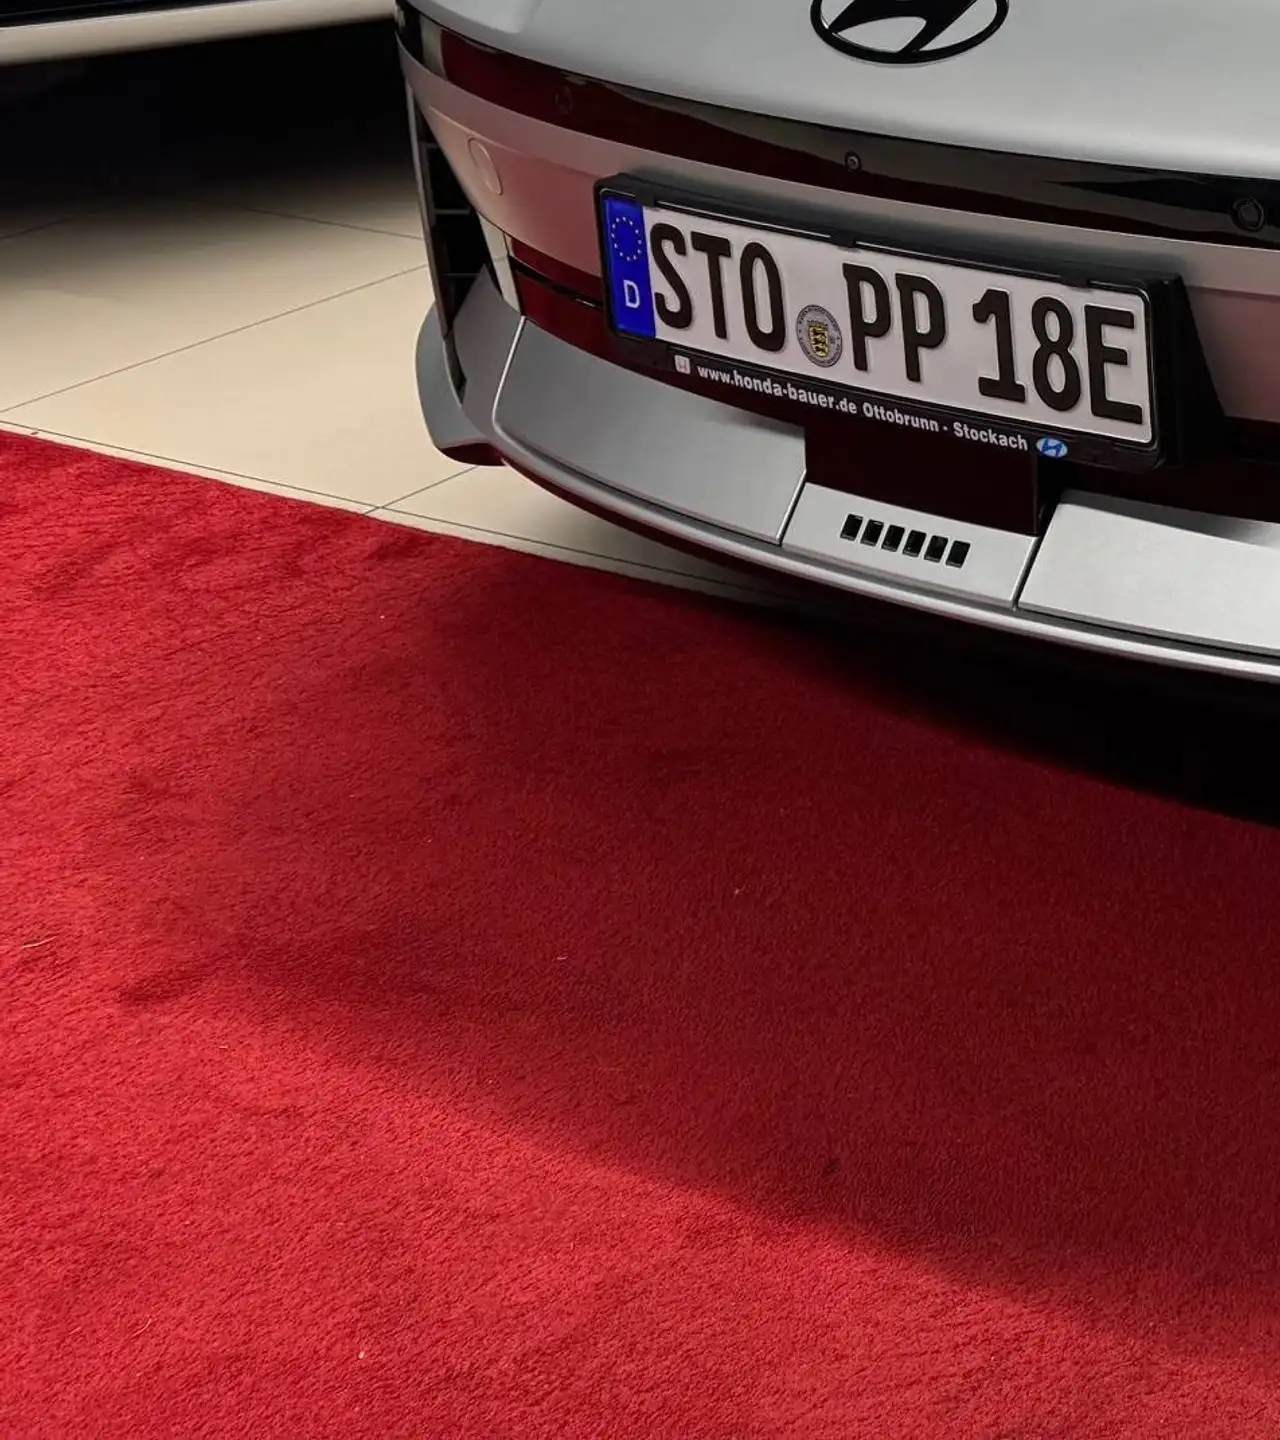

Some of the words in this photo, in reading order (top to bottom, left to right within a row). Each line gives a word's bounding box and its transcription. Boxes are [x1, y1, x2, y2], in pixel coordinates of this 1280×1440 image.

[623, 279, 641, 309] D
[649, 222, 786, 353] STO
[842, 262, 947, 383] PP
[972, 288, 1143, 425] 18E
[697, 364, 858, 415] www.honda-bauer.de
[862, 401, 940, 433] Ottobrunn
[953, 421, 1029, 451] Stockach
